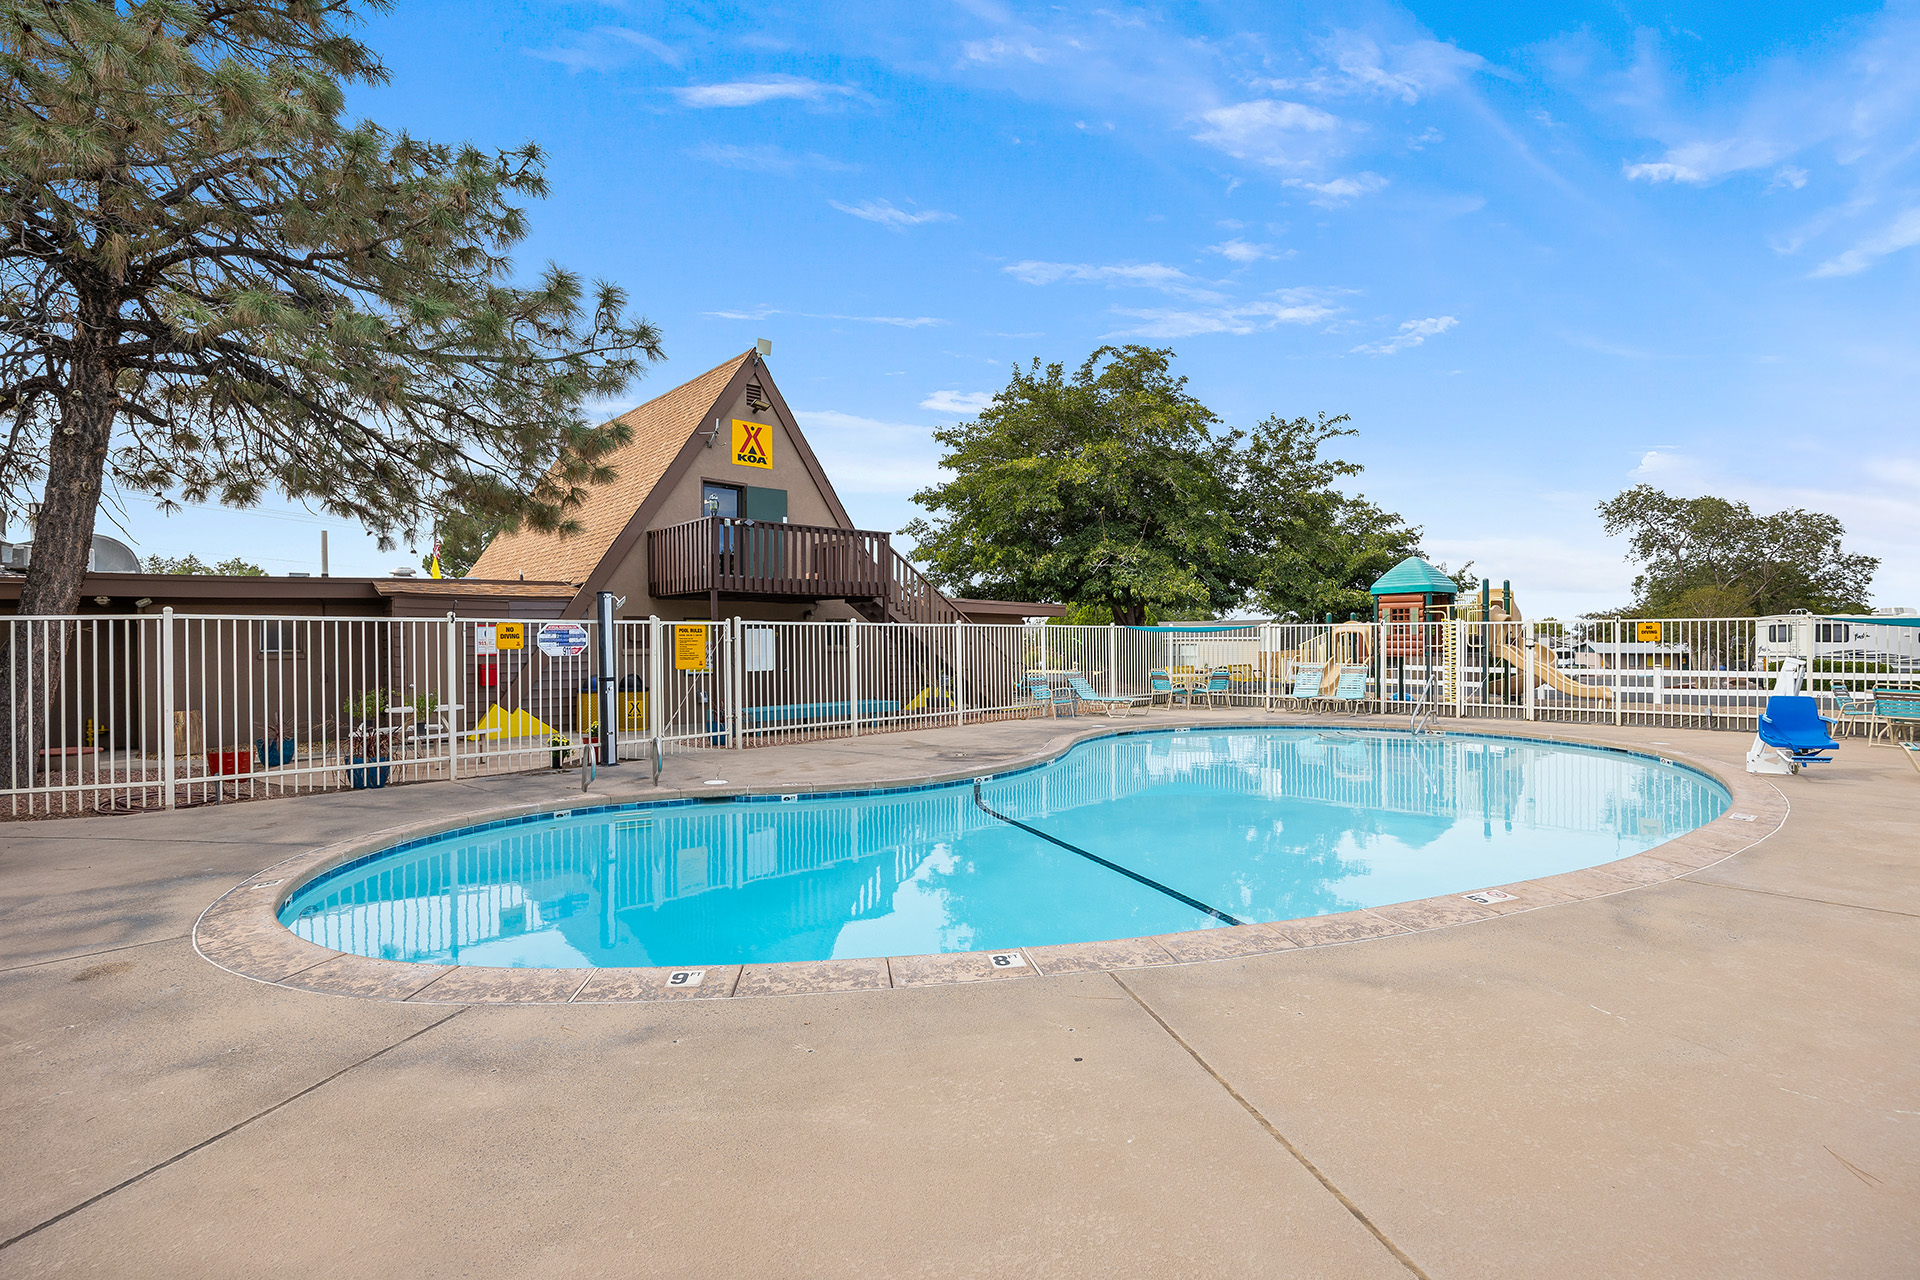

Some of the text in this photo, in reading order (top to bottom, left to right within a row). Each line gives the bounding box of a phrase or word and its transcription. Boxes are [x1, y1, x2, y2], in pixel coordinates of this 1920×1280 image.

[737, 453, 767, 465] KOA
[562, 646, 571, 656] 911
[992, 955, 1011, 966] 8
[670, 972, 690, 984] 9
